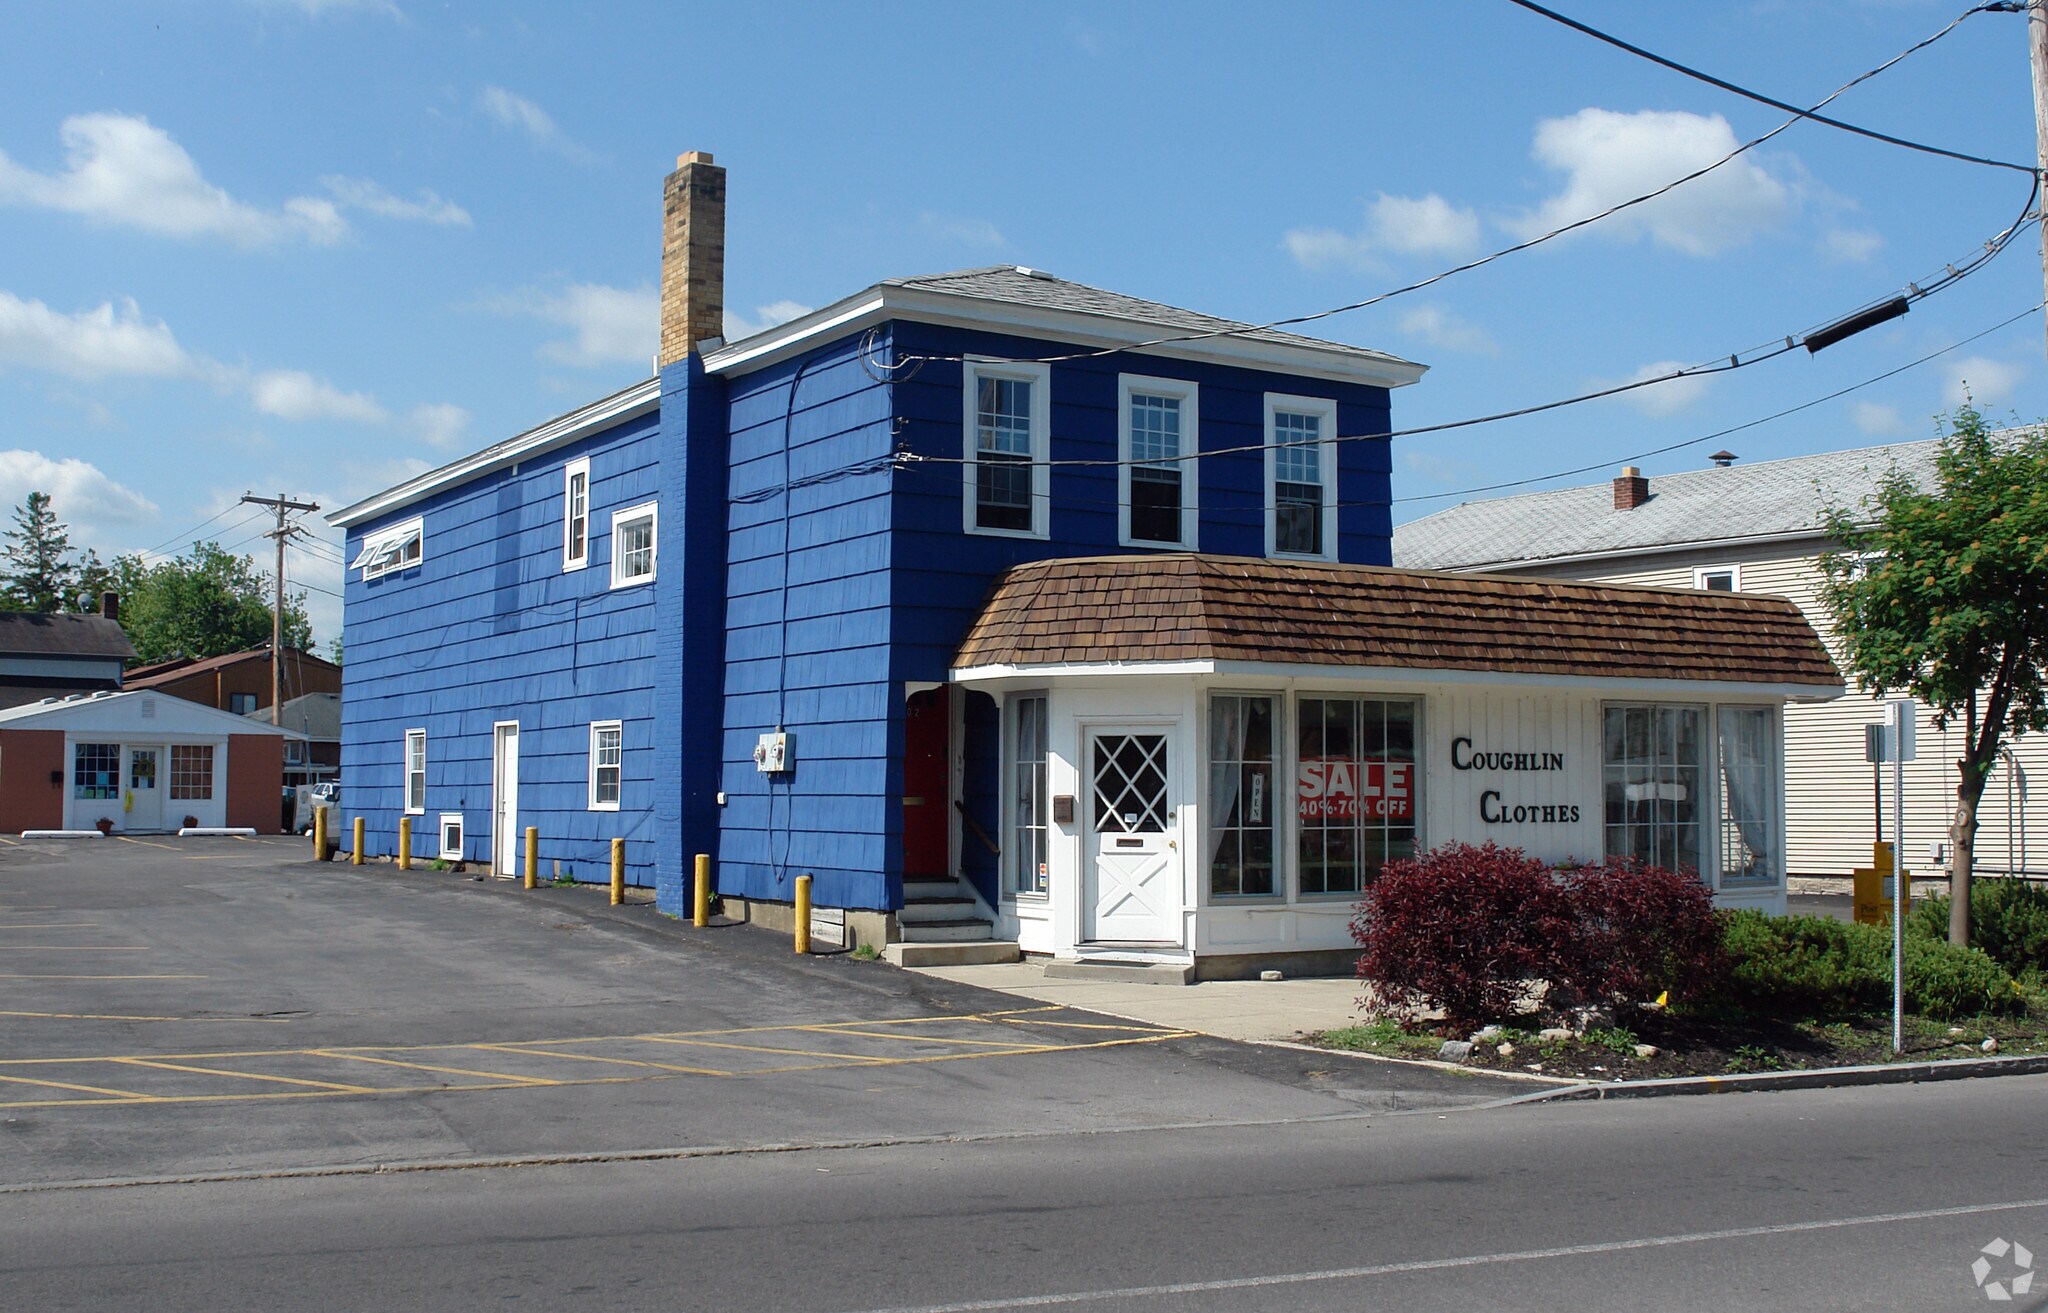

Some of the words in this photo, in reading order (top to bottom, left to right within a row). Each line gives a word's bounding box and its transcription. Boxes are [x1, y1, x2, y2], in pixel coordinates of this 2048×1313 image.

[1451, 737, 1564, 771] COUGHLIN
[1299, 760, 1408, 798] SALE
[1253, 777, 1261, 818] OPEN
[1376, 800, 1407, 816] OFF
[1480, 790, 1580, 824] CLOTHES
